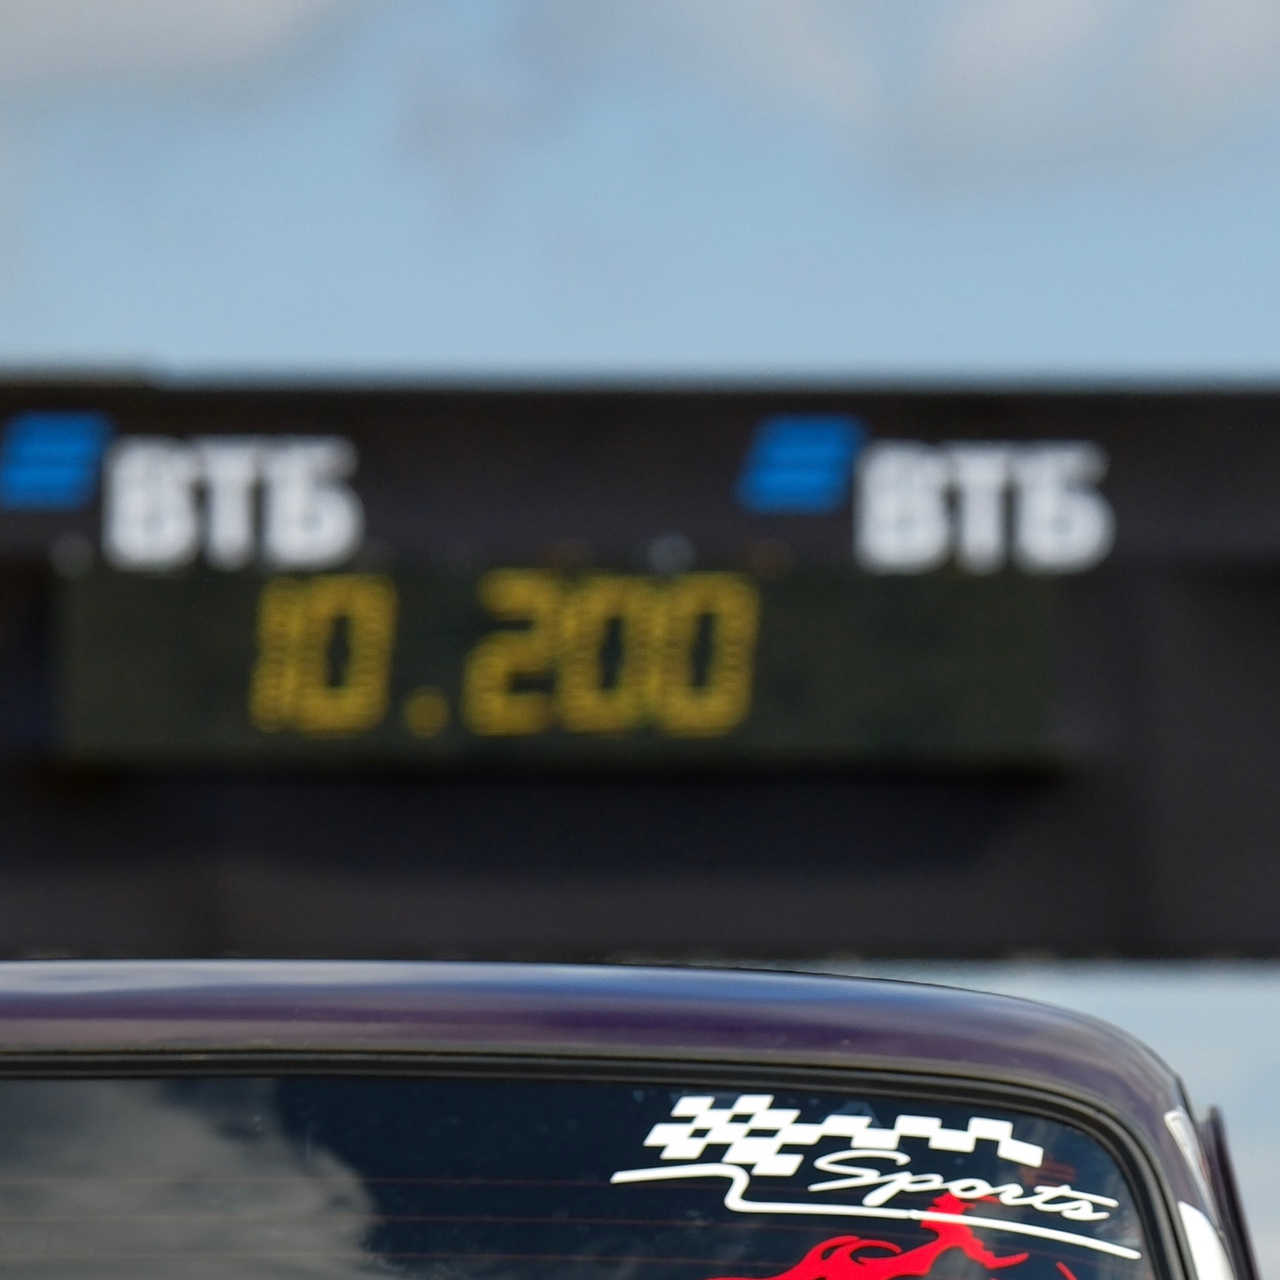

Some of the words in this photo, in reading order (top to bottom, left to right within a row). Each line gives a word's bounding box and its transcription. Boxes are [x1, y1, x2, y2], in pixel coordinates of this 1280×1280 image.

[103, 436, 364, 570] ВТБ
[857, 442, 1113, 573] ВТБ
[250, 570, 758, 735] 10.200
[808, 1149, 1118, 1221] Sports
